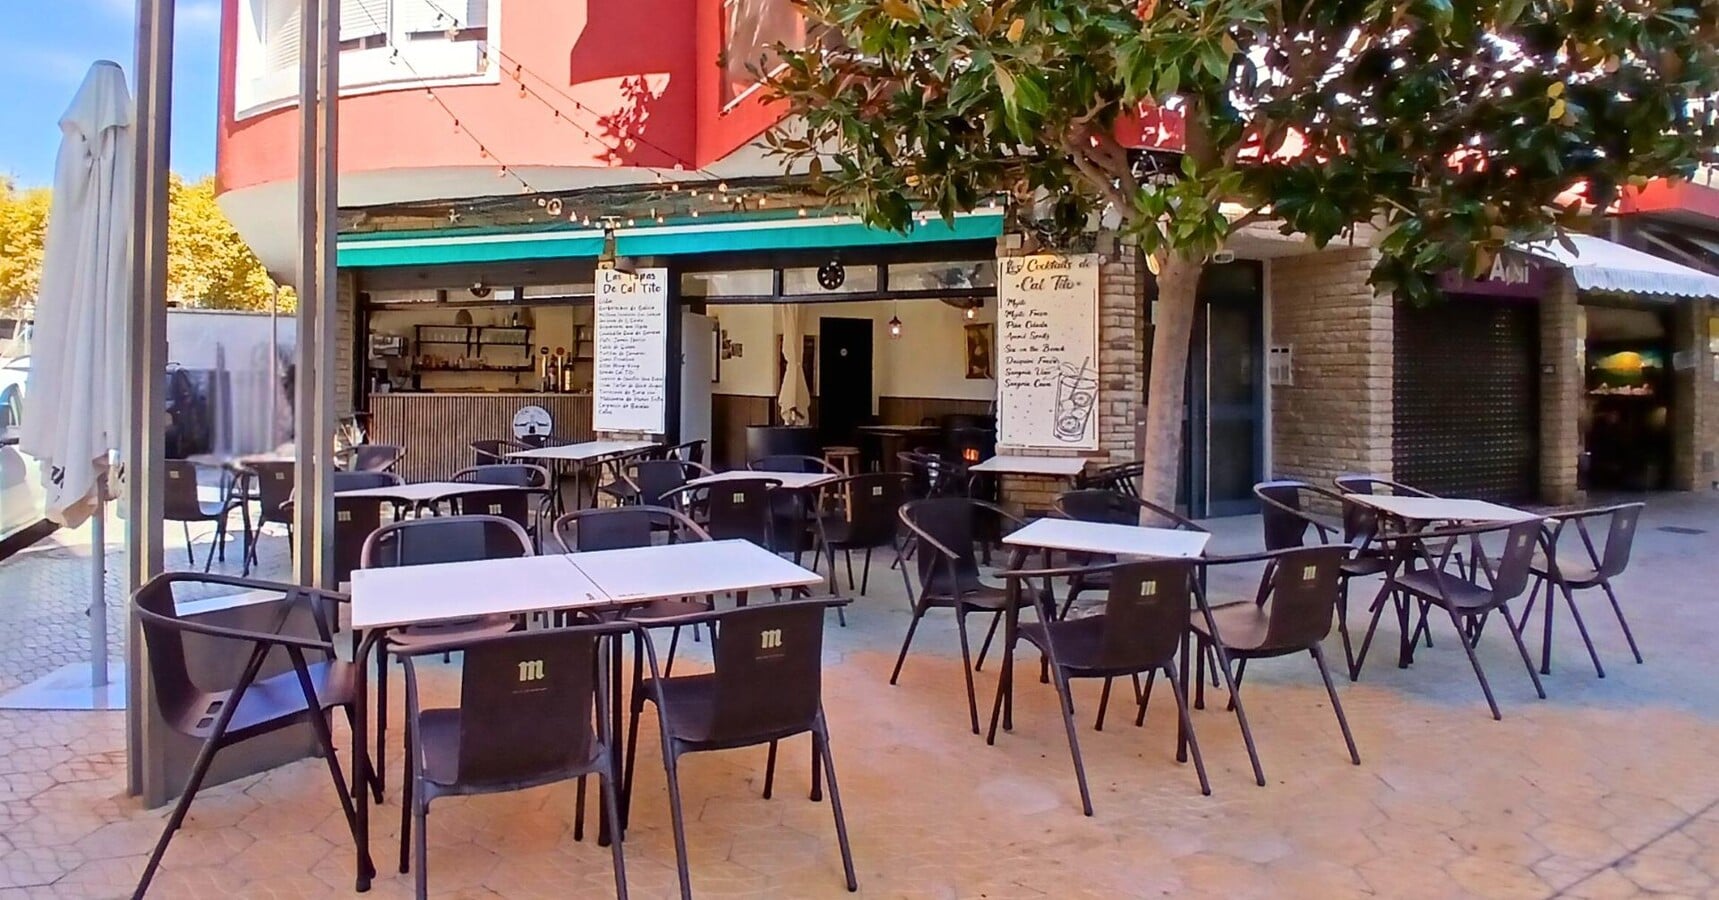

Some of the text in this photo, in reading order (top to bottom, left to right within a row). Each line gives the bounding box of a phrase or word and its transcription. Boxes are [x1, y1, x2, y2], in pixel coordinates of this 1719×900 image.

[1027, 258, 1072, 272] Cocktails
[605, 272, 621, 283] Las
[1020, 275, 1074, 292] Cal Tito
[603, 282, 662, 294] De Cal Tito
[761, 628, 782, 649] m
[518, 660, 545, 682] m
